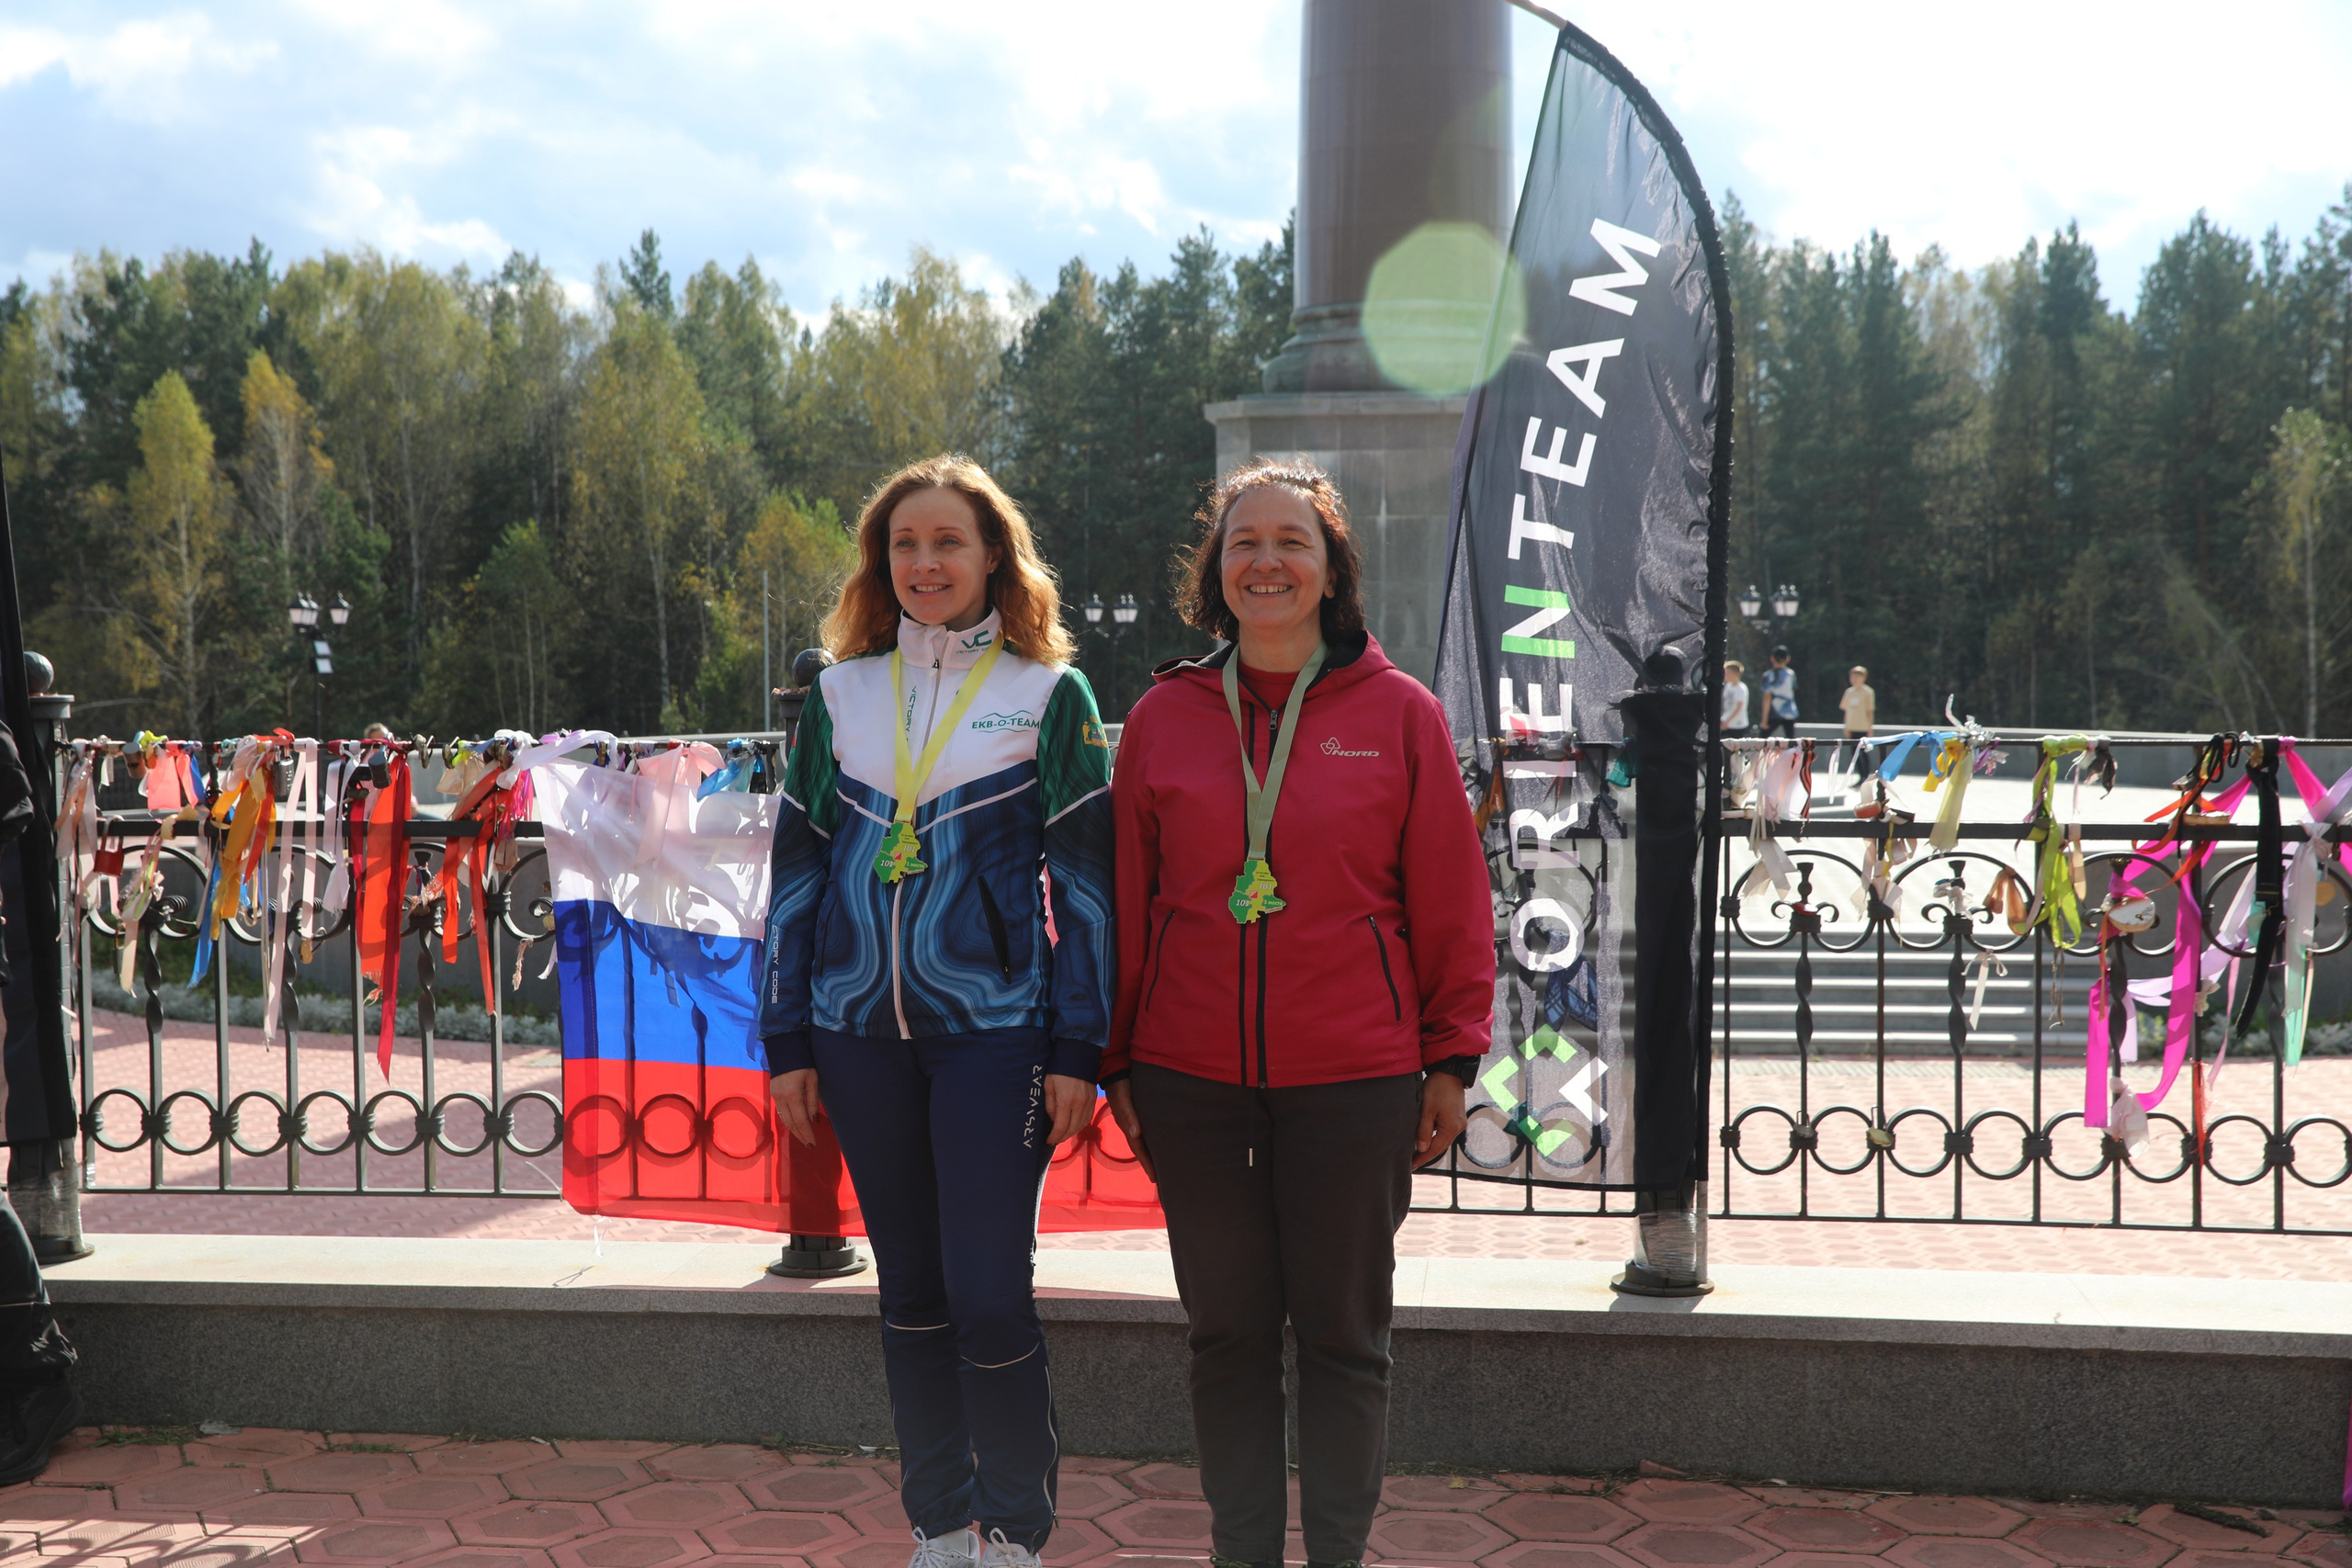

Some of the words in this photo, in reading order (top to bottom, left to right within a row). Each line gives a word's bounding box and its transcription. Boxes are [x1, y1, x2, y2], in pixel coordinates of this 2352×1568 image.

[1499, 218, 1660, 972] ORIENTEAM
[905, 685, 917, 732] VICTORY
[971, 718, 1040, 728] EKB-O-TEAM
